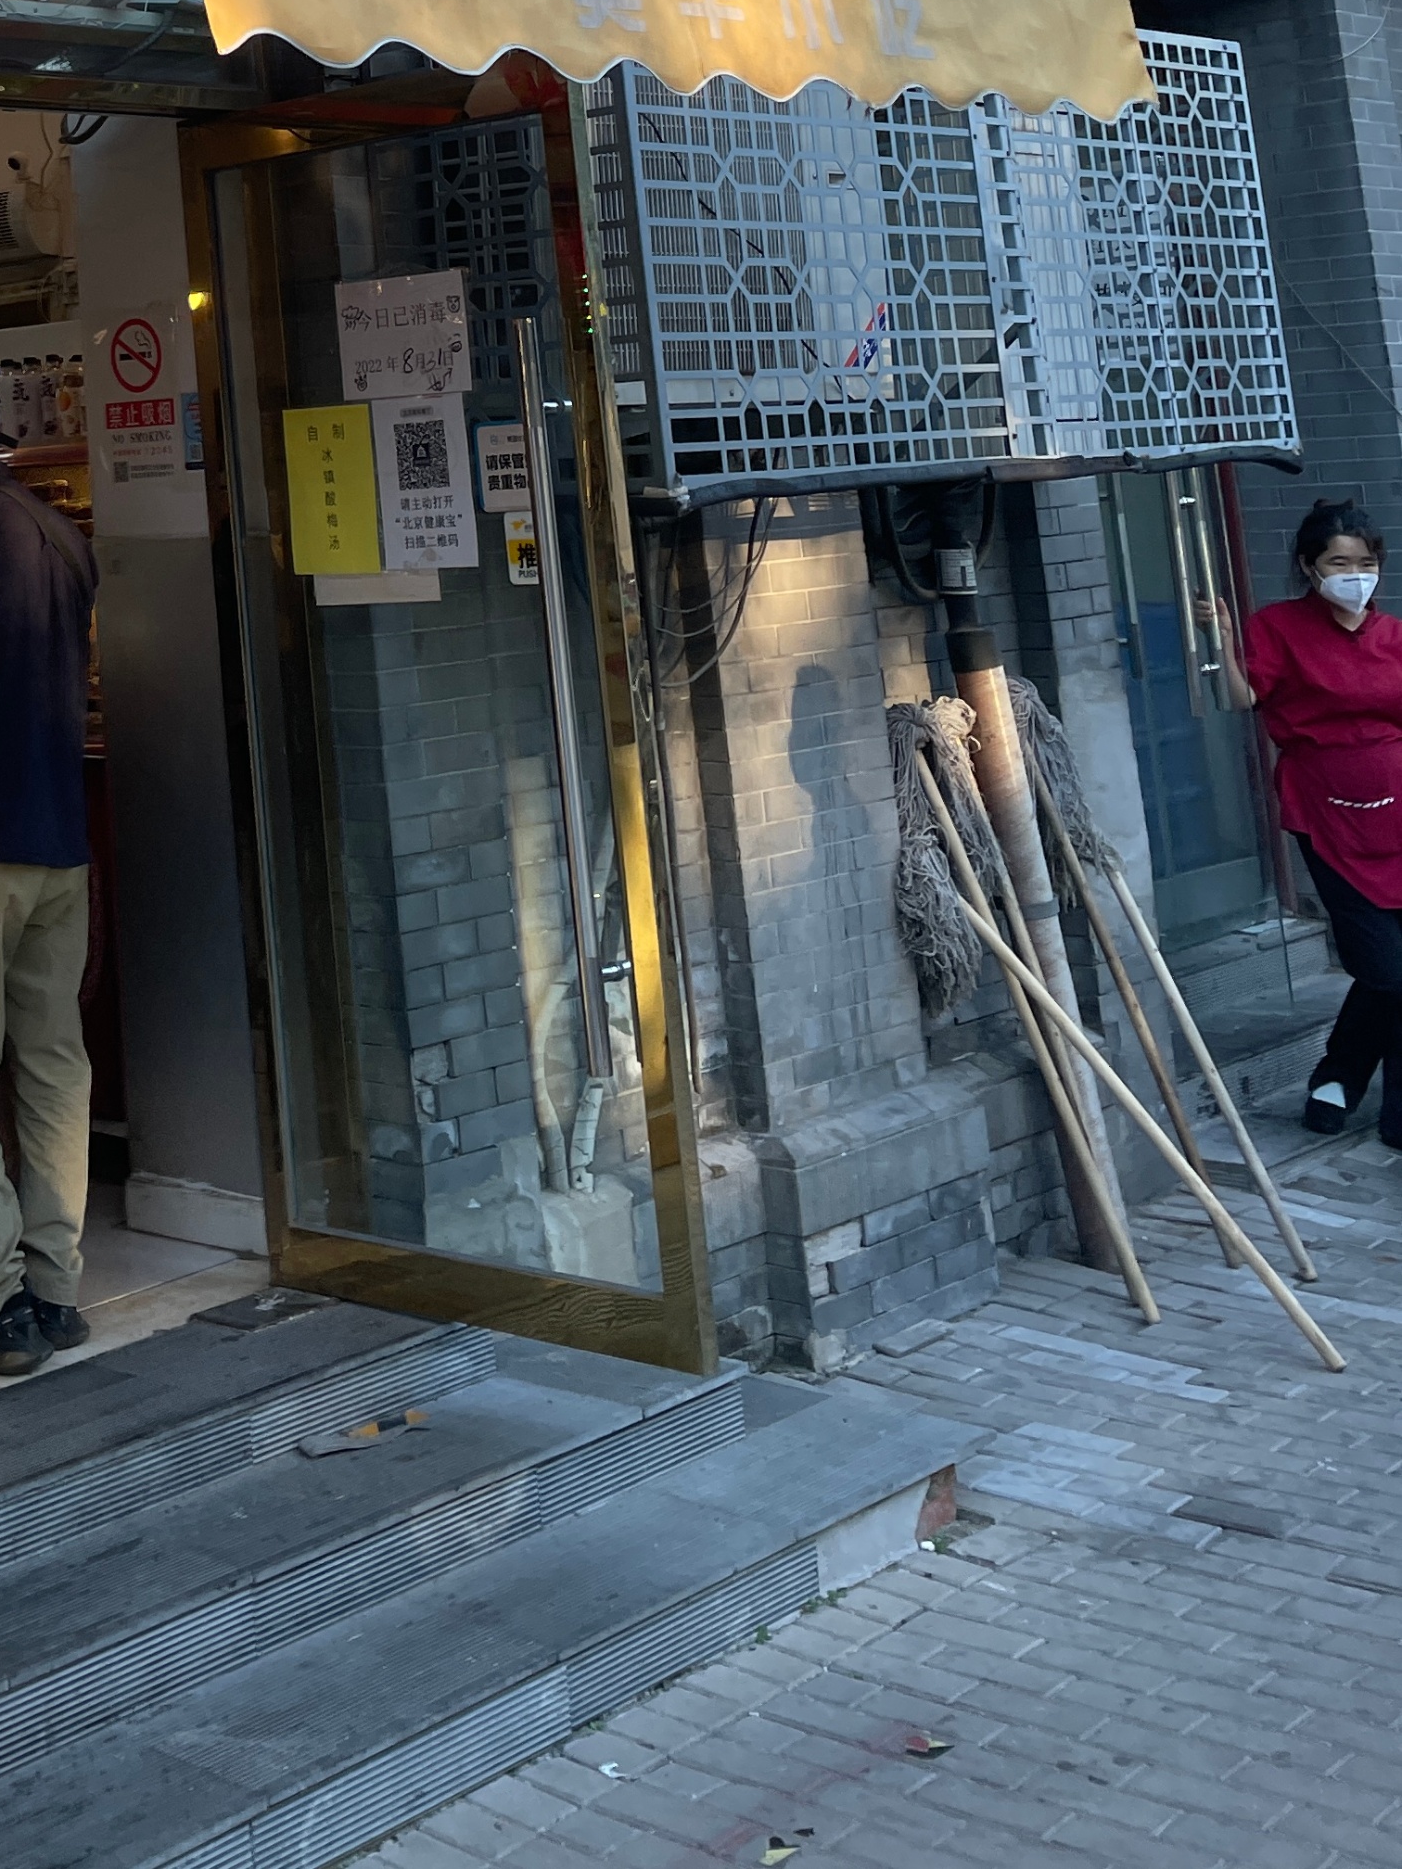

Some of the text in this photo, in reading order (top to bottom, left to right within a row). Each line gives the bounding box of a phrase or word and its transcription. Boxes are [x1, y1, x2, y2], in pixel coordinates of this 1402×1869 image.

[108, 400, 173, 428] 禁止吸烟
[486, 453, 525, 471] 请保管
[488, 474, 527, 491] 贵重物
[517, 543, 537, 568] 推
